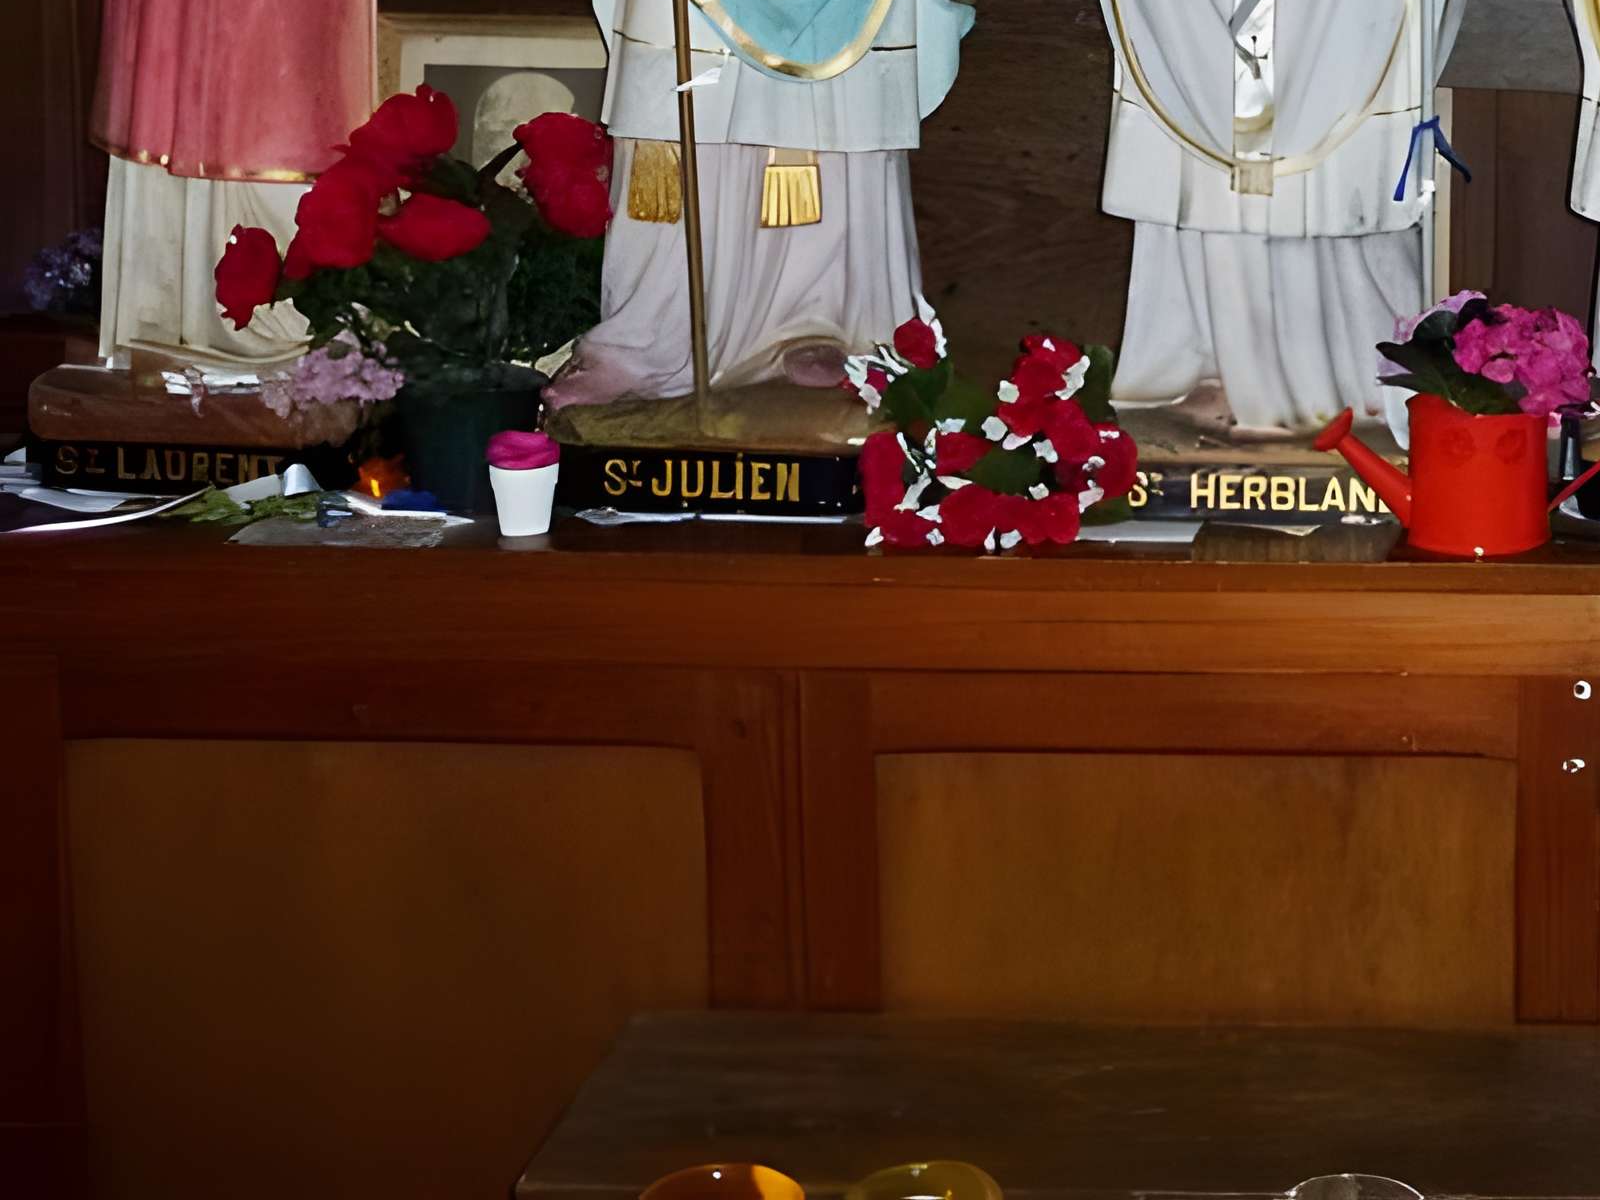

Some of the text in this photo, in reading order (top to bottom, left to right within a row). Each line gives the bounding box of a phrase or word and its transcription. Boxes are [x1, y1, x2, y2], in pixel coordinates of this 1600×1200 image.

[117, 446, 285, 484] LAURENT
[651, 456, 800, 502] JULIEN
[1190, 472, 1392, 514] HERBLAN
